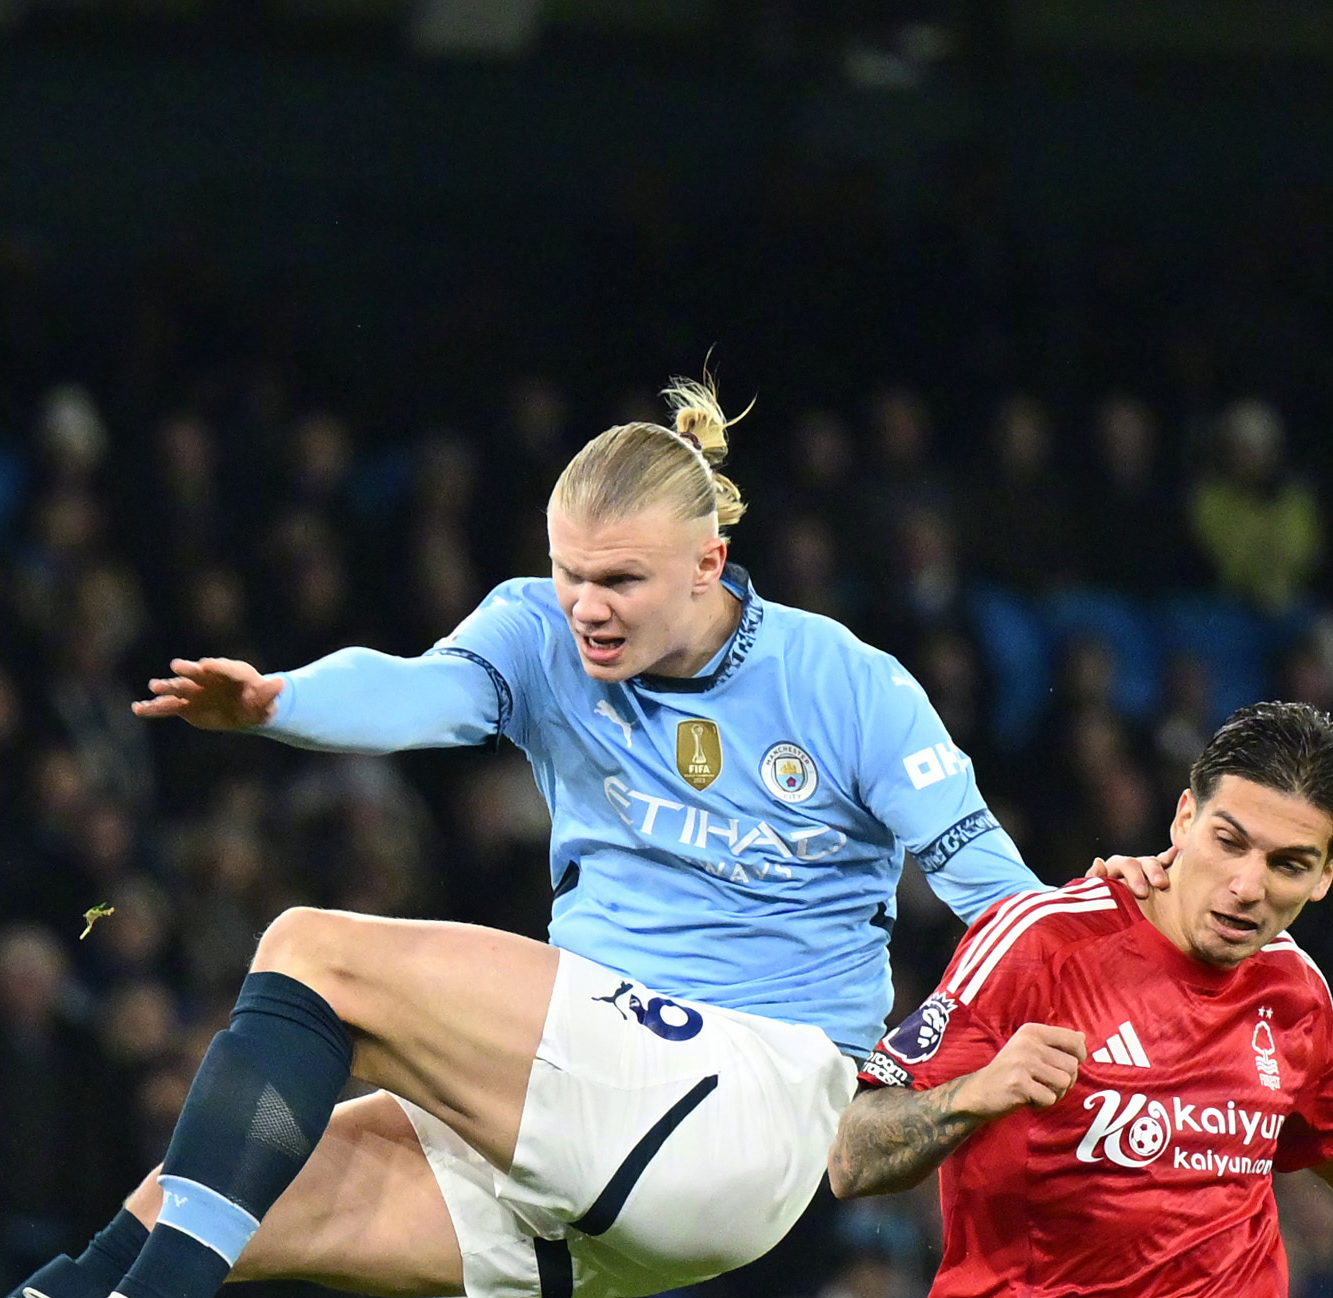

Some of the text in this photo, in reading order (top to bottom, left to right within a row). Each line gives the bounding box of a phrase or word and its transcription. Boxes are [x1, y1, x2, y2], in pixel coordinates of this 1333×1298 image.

[766, 745, 810, 766] MANCHESTER
[688, 764, 711, 774] FIFA
[604, 776, 847, 861] ETIHAD
[870, 1051, 908, 1081] room
